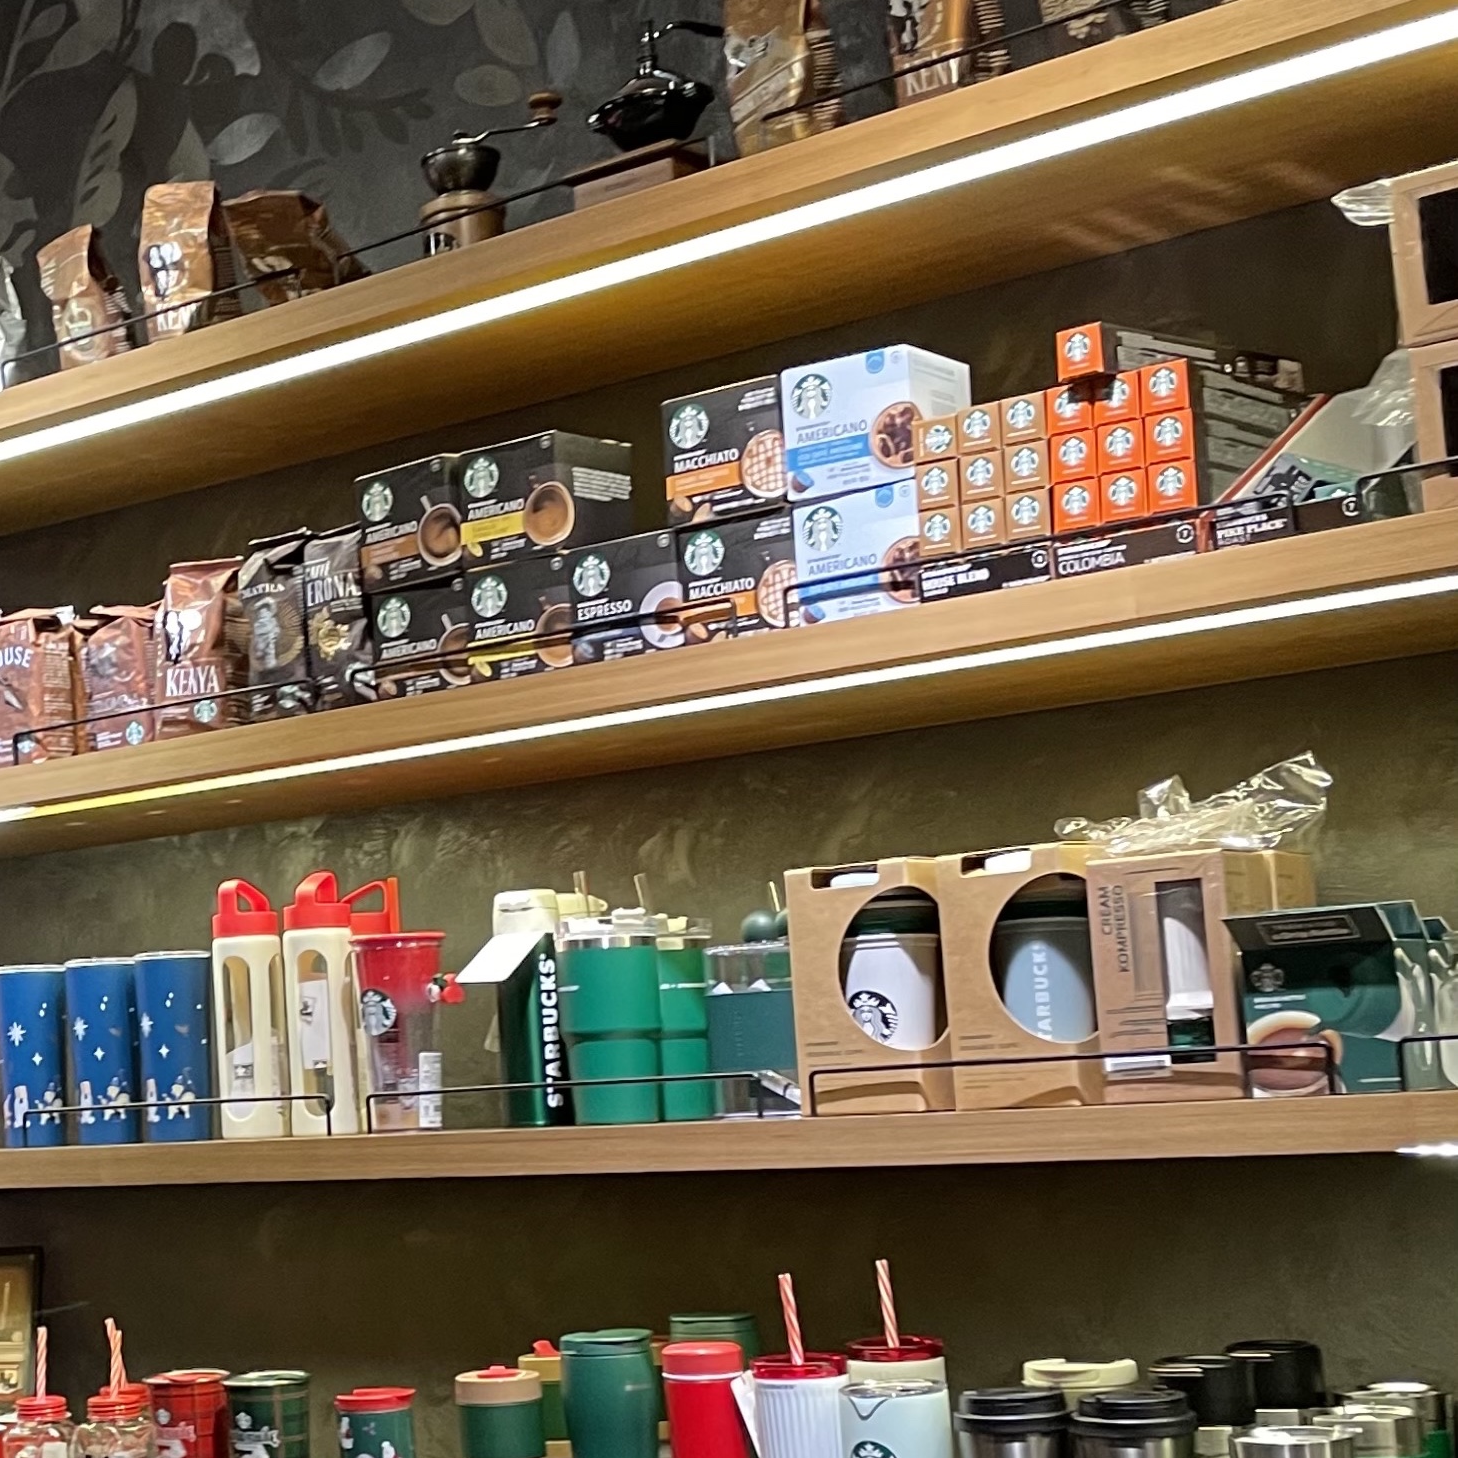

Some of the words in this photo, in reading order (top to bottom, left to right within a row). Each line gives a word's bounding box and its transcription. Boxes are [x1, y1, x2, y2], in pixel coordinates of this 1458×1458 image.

[903, 52, 961, 96] KENY
[796, 419, 868, 444] AMERICANO
[673, 448, 739, 473] MACCHIATO
[467, 498, 524, 520] AMERICANO
[365, 521, 418, 544] AMERICANO
[808, 553, 878, 576] AMERICANO
[1058, 551, 1126, 575] COLOMBIA
[307, 572, 361, 606] ERONA
[688, 577, 756, 600] MACCHIATO
[577, 600, 633, 620] ESPRESSO
[474, 619, 535, 640] AMERICANO
[165, 664, 220, 697] KENYA
[1097, 886, 1113, 936] CREAM
[1112, 884, 1130, 973] KOMPRESSO
[538, 953, 564, 1108] STARBUCKS
